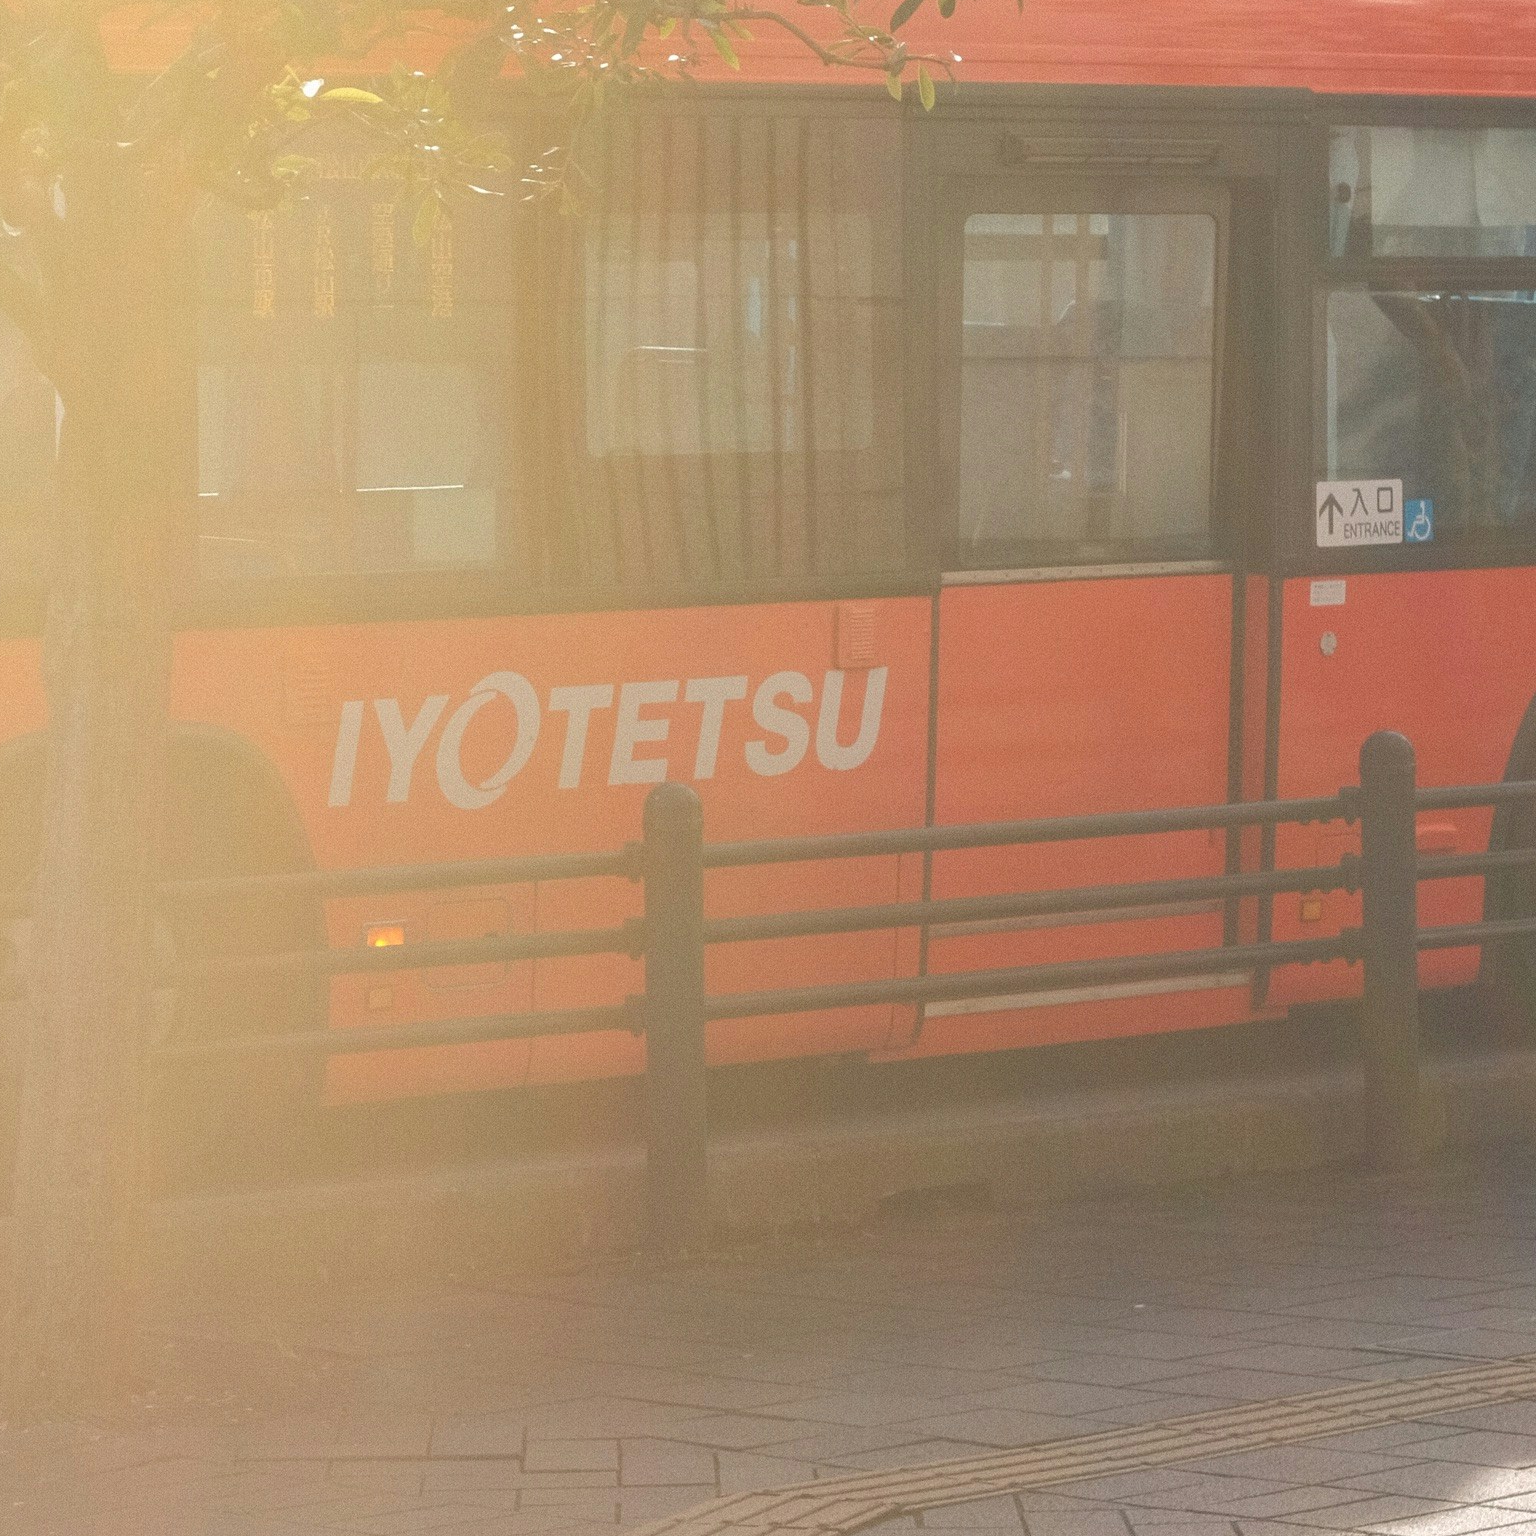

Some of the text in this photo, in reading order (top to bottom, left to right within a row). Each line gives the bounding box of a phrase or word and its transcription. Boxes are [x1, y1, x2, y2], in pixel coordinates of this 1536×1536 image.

[1350, 487, 1394, 516] 入口
[1344, 520, 1401, 540] ENTRANCE
[328, 666, 889, 810] IYOTETSU
